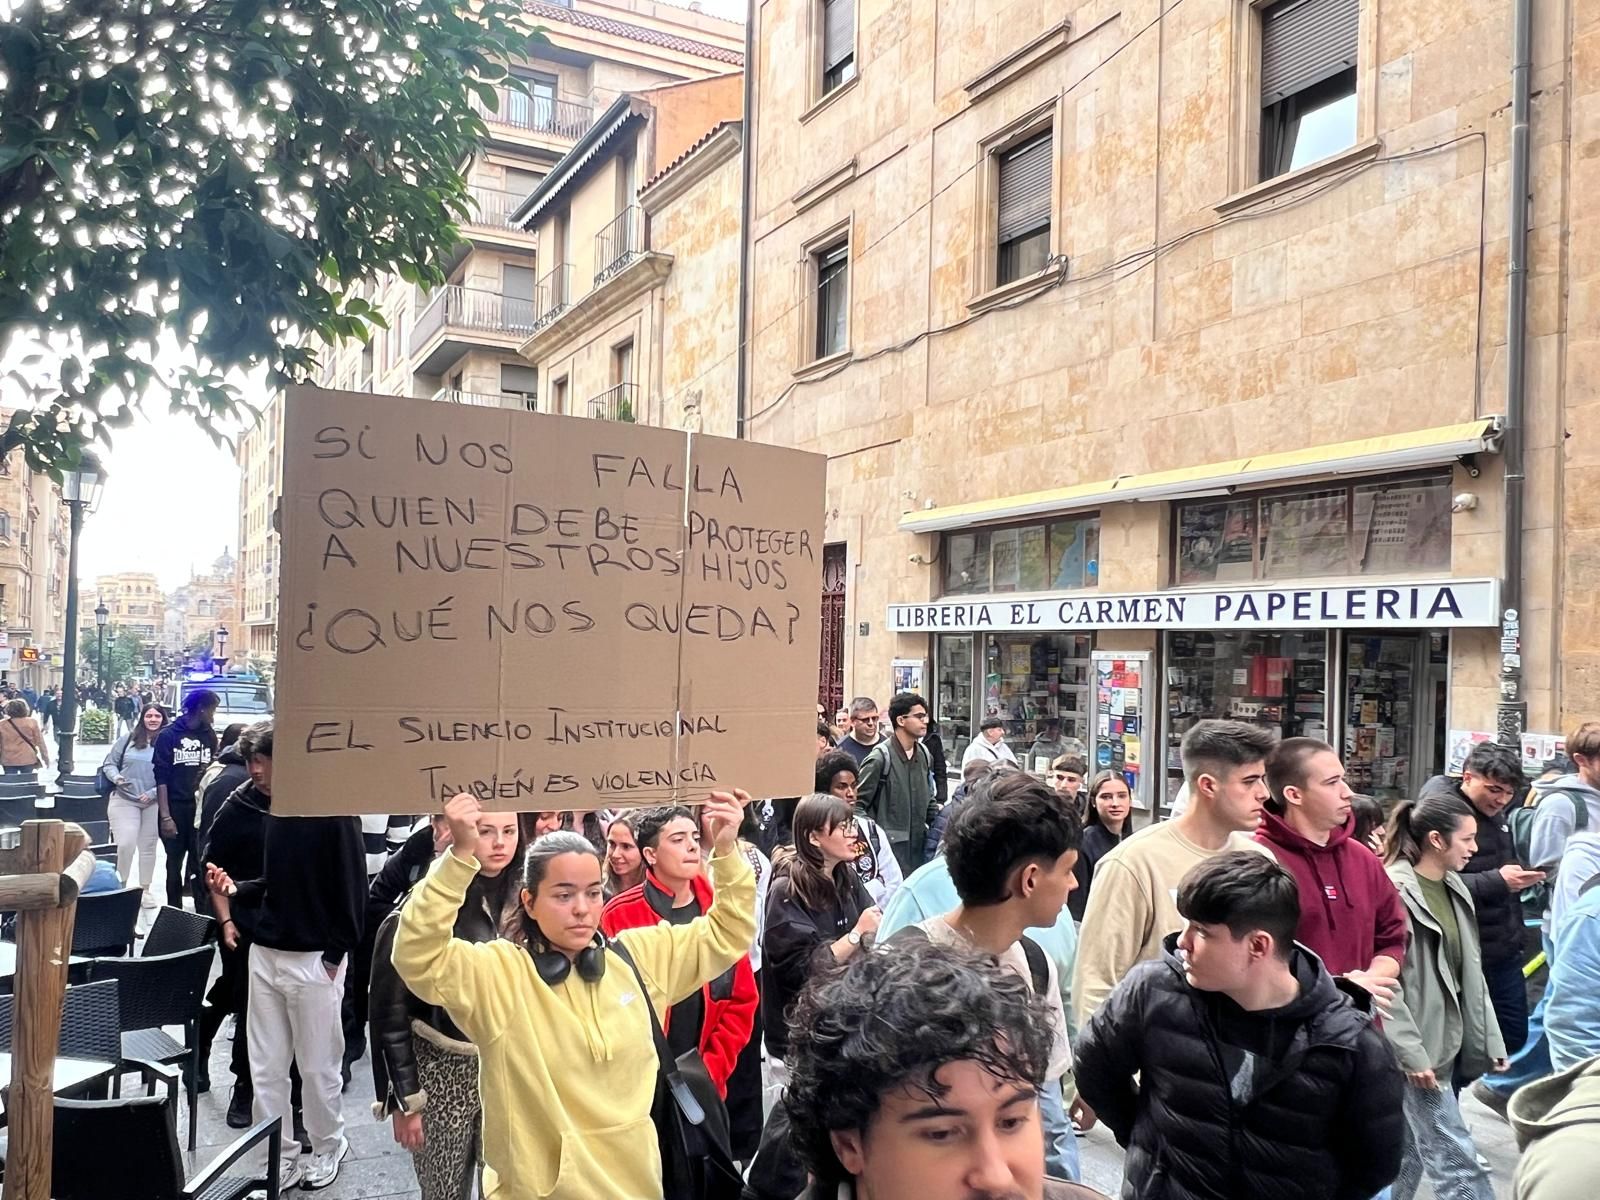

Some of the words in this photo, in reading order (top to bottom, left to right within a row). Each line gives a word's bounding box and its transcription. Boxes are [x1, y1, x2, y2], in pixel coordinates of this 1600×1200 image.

[416, 433, 513, 474] NOS
[592, 453, 743, 503] FALLA
[318, 488, 475, 529] QUIEN
[510, 504, 640, 545] DEBE
[688, 510, 814, 563] PROTEGER
[322, 533, 358, 571] A
[396, 535, 681, 577] NUESTROS
[296, 596, 458, 654] ¿QUÉ
[487, 599, 596, 638] NOS
[624, 602, 801, 645] QUEDA?
[895, 604, 993, 628] LIBRERIA
[1010, 604, 1042, 625] EL
[1058, 596, 1188, 624] CARMEN
[1214, 586, 1465, 622] PAPELERIA
[306, 720, 376, 753] EL
[398, 716, 532, 743] SILENCIO
[543, 773, 581, 793] ES
